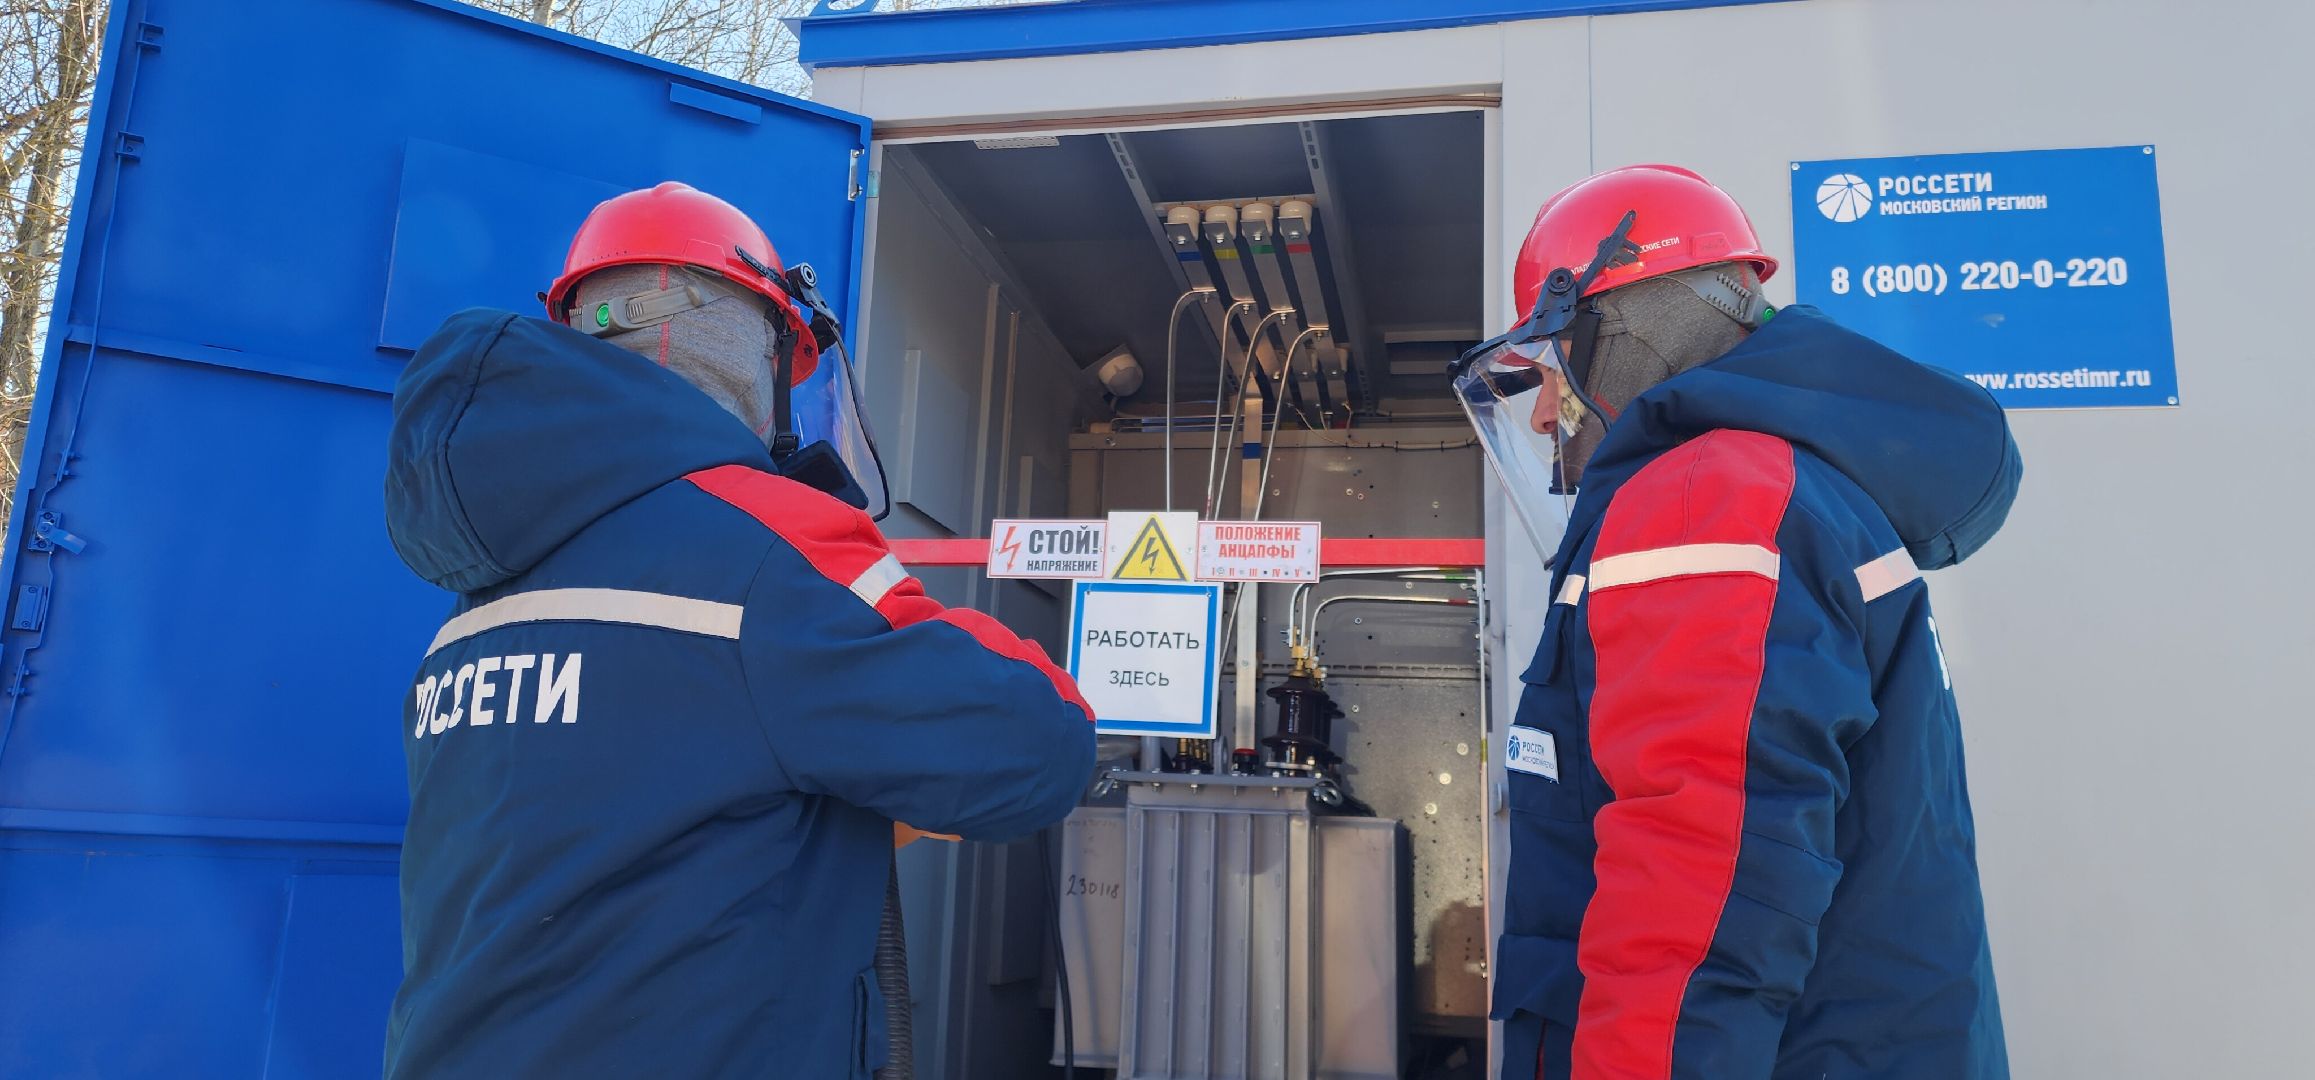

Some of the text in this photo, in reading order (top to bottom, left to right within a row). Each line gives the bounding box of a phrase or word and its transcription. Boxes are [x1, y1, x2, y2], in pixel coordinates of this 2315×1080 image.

[1879, 172, 1993, 197] РОССЕТИ
[1879, 195, 2048, 216] МОСКОВСКИЙ РЕГИОН
[1831, 257, 2128, 298] 8 (800) 220-0-220
[1964, 368, 2151, 389] ww.rossetimr.ru
[1029, 525, 1099, 554] СТОЙ!
[1215, 526, 1301, 541] ПОЛОЖЕНИЕ
[1219, 543, 1295, 559] АНЦАПФЫ
[1027, 560, 1098, 572] НАПРЯЖЕНИЕ
[1087, 630, 1200, 650] РАБОТАТЬ
[1109, 670, 1170, 688] ЗДЕСЬ
